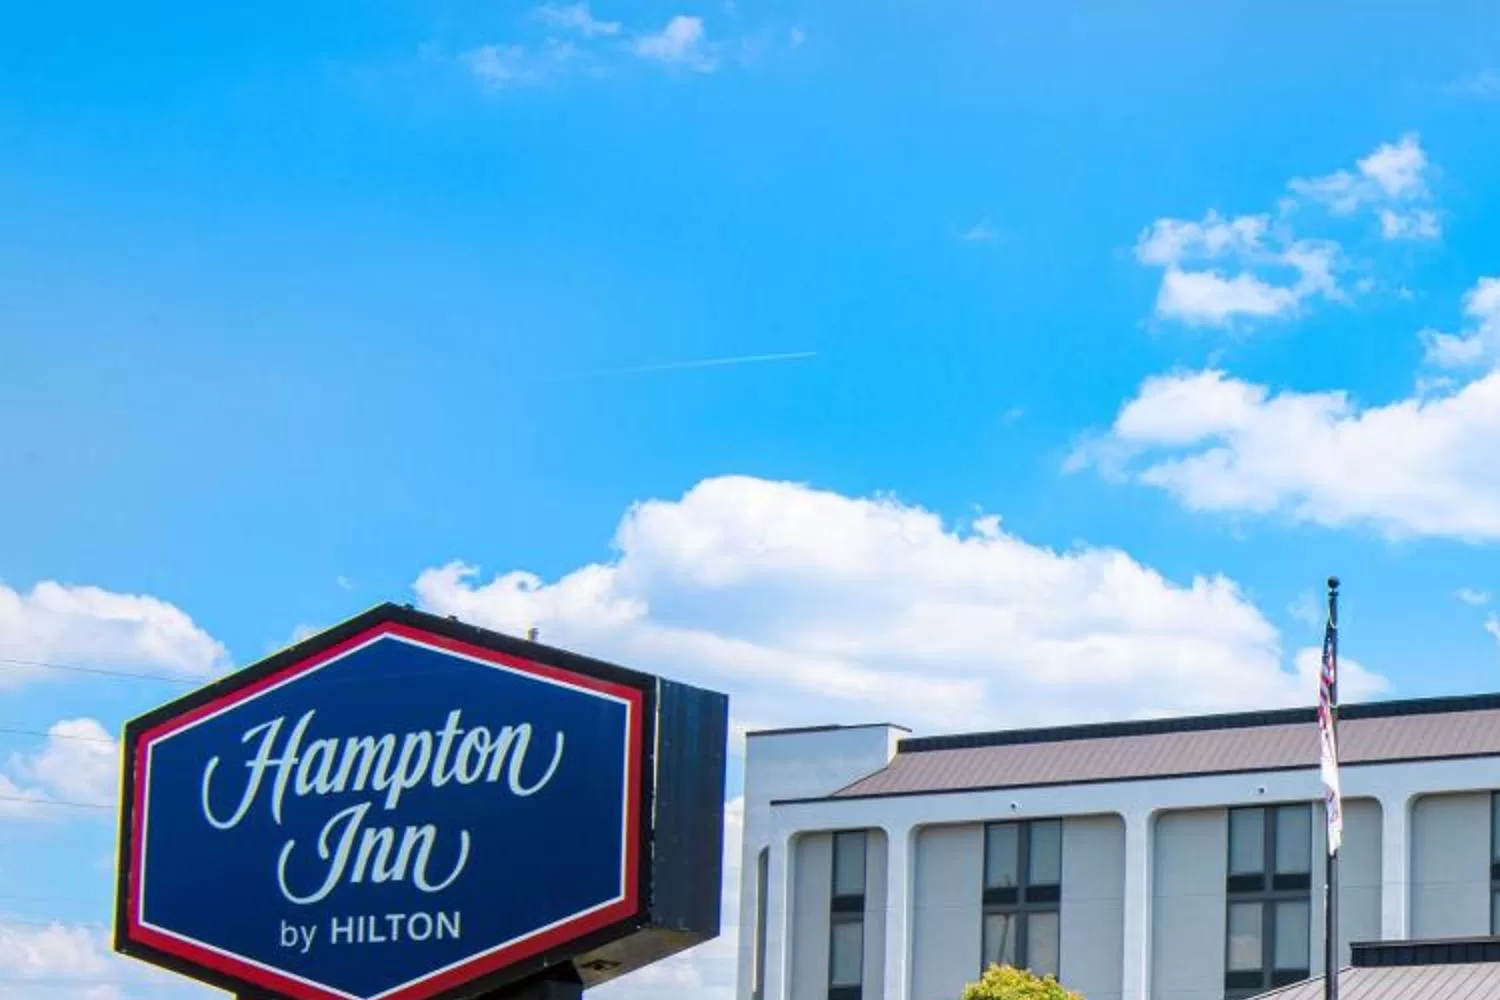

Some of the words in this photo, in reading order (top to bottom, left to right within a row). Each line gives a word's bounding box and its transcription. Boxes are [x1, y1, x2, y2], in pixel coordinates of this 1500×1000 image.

[202, 709, 564, 829] Hampton
[277, 801, 470, 904] Inn
[281, 920, 317, 953] by
[330, 911, 461, 944] HILTON
